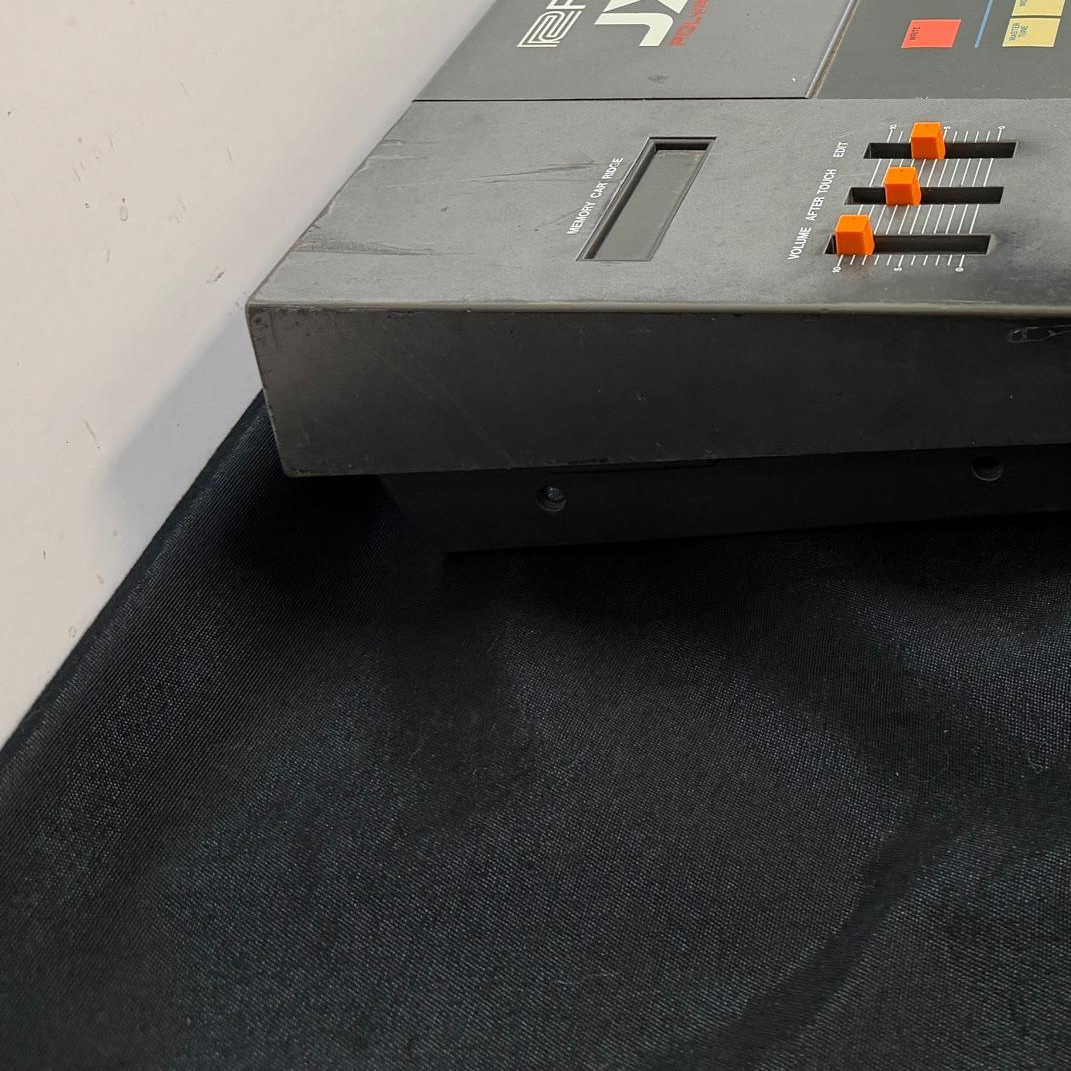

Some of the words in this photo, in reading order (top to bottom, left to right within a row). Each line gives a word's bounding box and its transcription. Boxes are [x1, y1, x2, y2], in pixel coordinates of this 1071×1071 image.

[909, 26, 920, 40] WRITE
[833, 141, 849, 158] EDIT
[805, 196, 824, 221] AFTER
[817, 169, 837, 199] TOUCH
[567, 201, 596, 235] MEMORY
[788, 227, 812, 260] VOLUME
